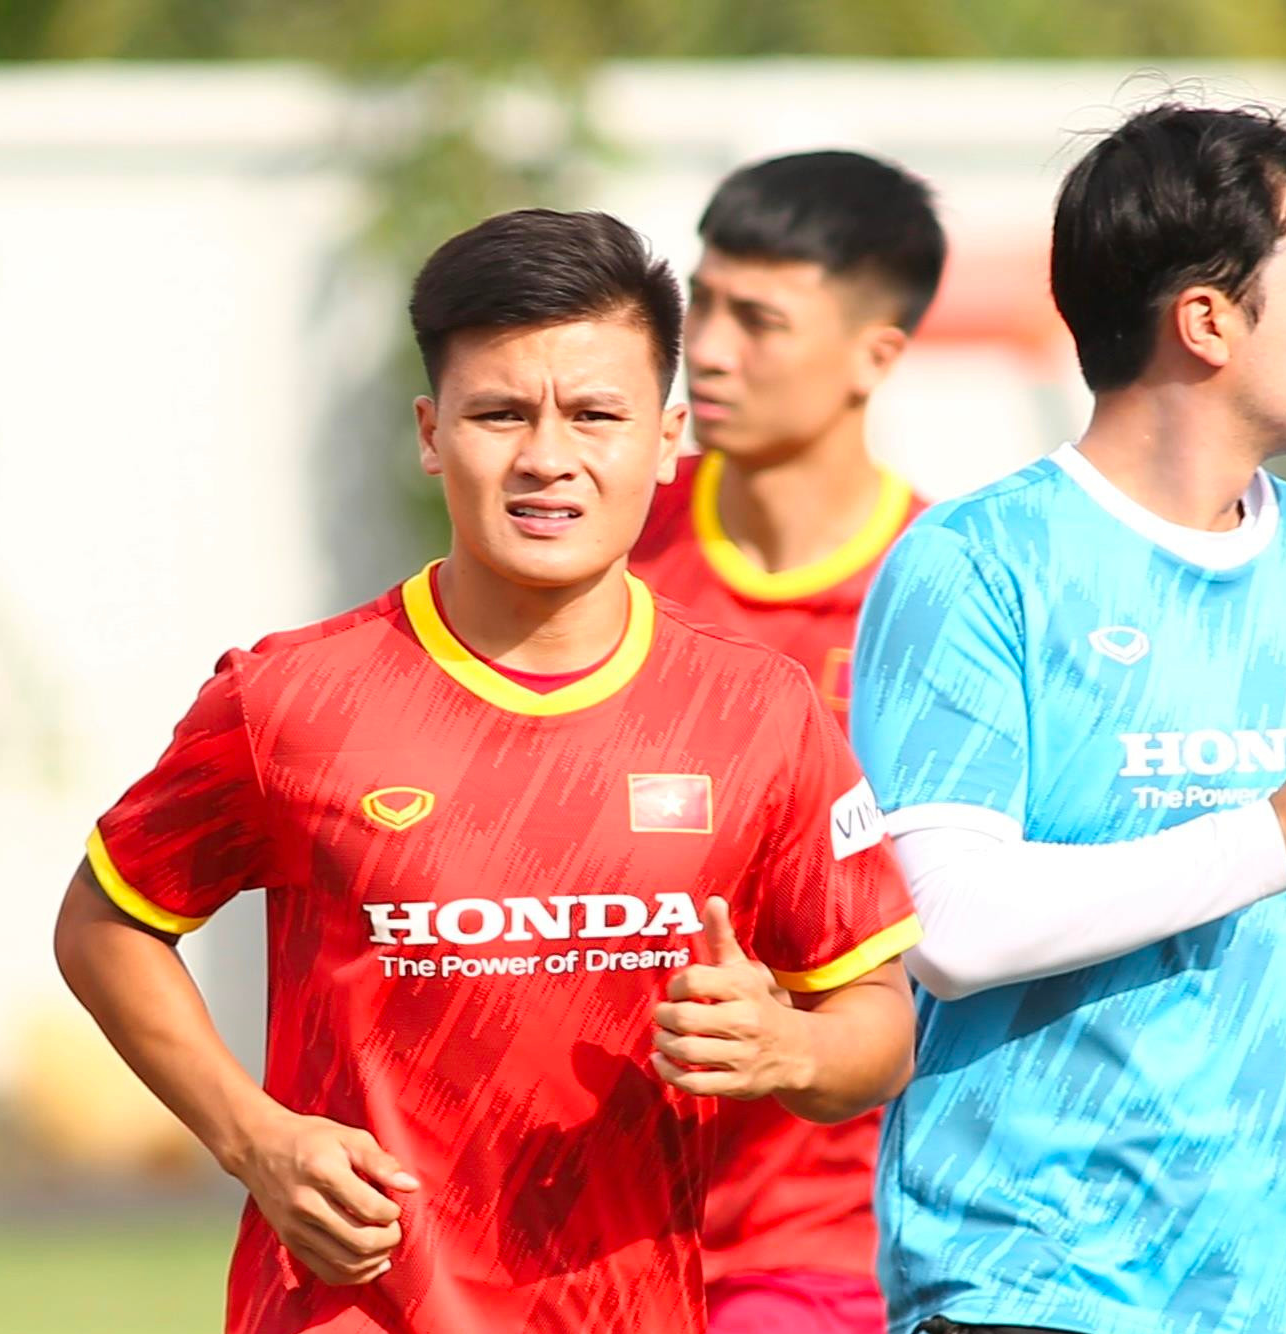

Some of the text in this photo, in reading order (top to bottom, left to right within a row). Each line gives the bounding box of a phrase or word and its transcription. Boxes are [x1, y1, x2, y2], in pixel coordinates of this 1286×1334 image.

[1131, 786, 1183, 810] The
[362, 892, 703, 946] HONDA
[378, 946, 690, 978] The Power of Dreams
